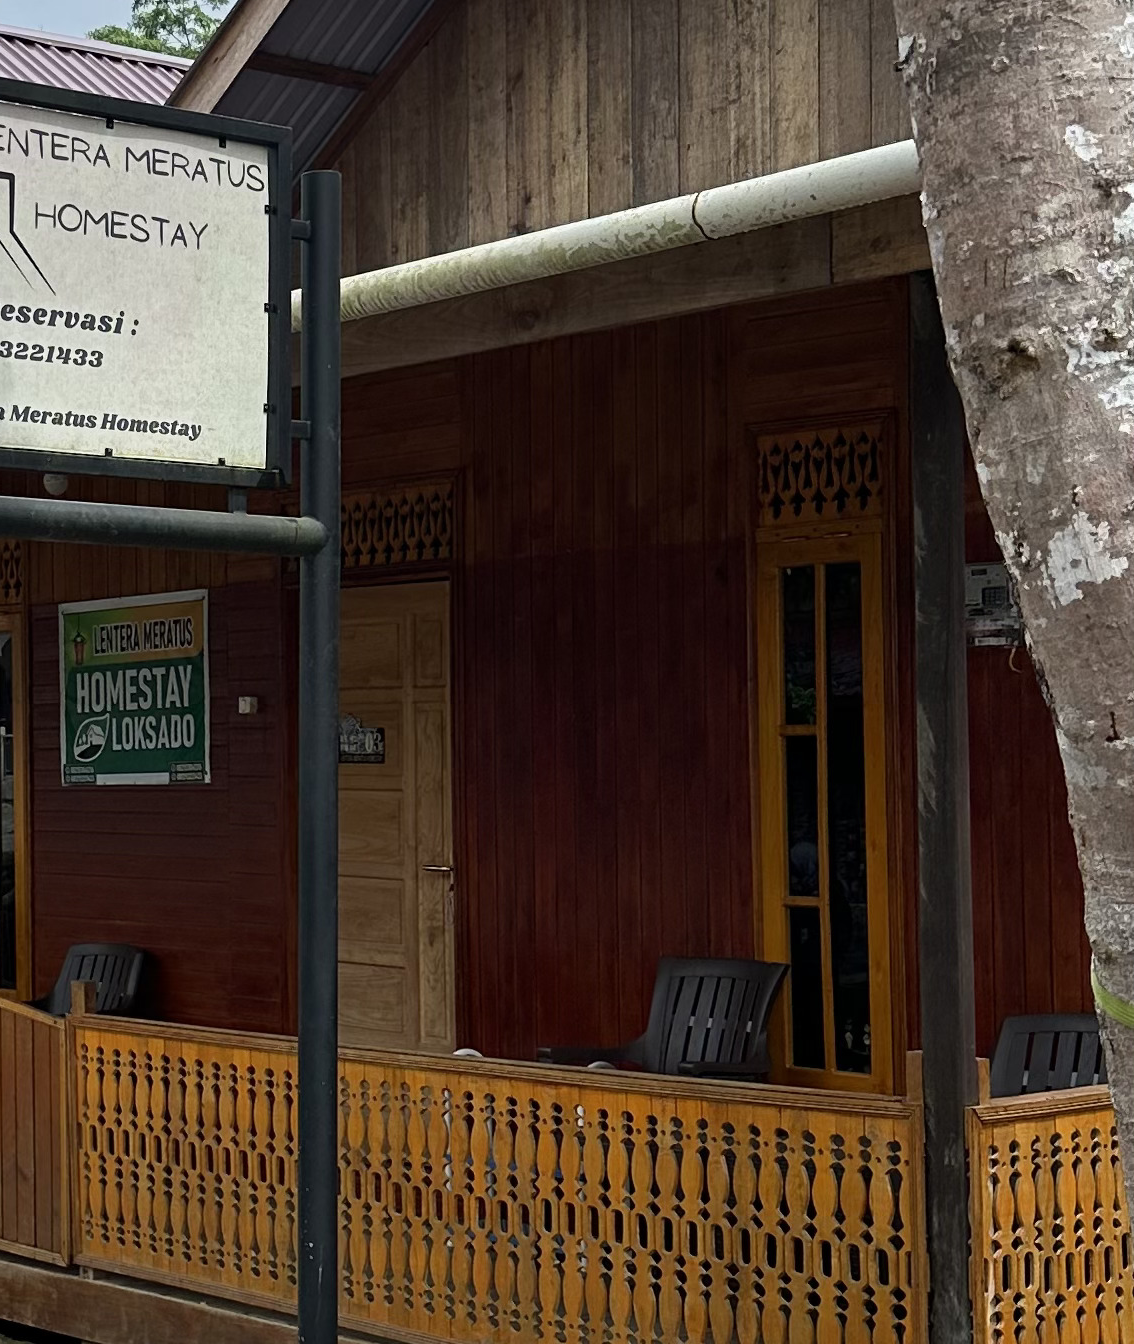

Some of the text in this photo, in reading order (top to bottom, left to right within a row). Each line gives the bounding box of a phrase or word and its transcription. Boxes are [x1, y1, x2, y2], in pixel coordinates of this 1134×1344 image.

[125, 147, 266, 193] MERATUS
[34, 202, 209, 251] HOMESTAY
[9, 403, 98, 430] Meratus
[100, 412, 203, 442] Homestay
[94, 618, 193, 655] LENTERA MERATUS
[76, 664, 193, 713] HOMESTAY
[112, 714, 195, 751] LOKSADO
